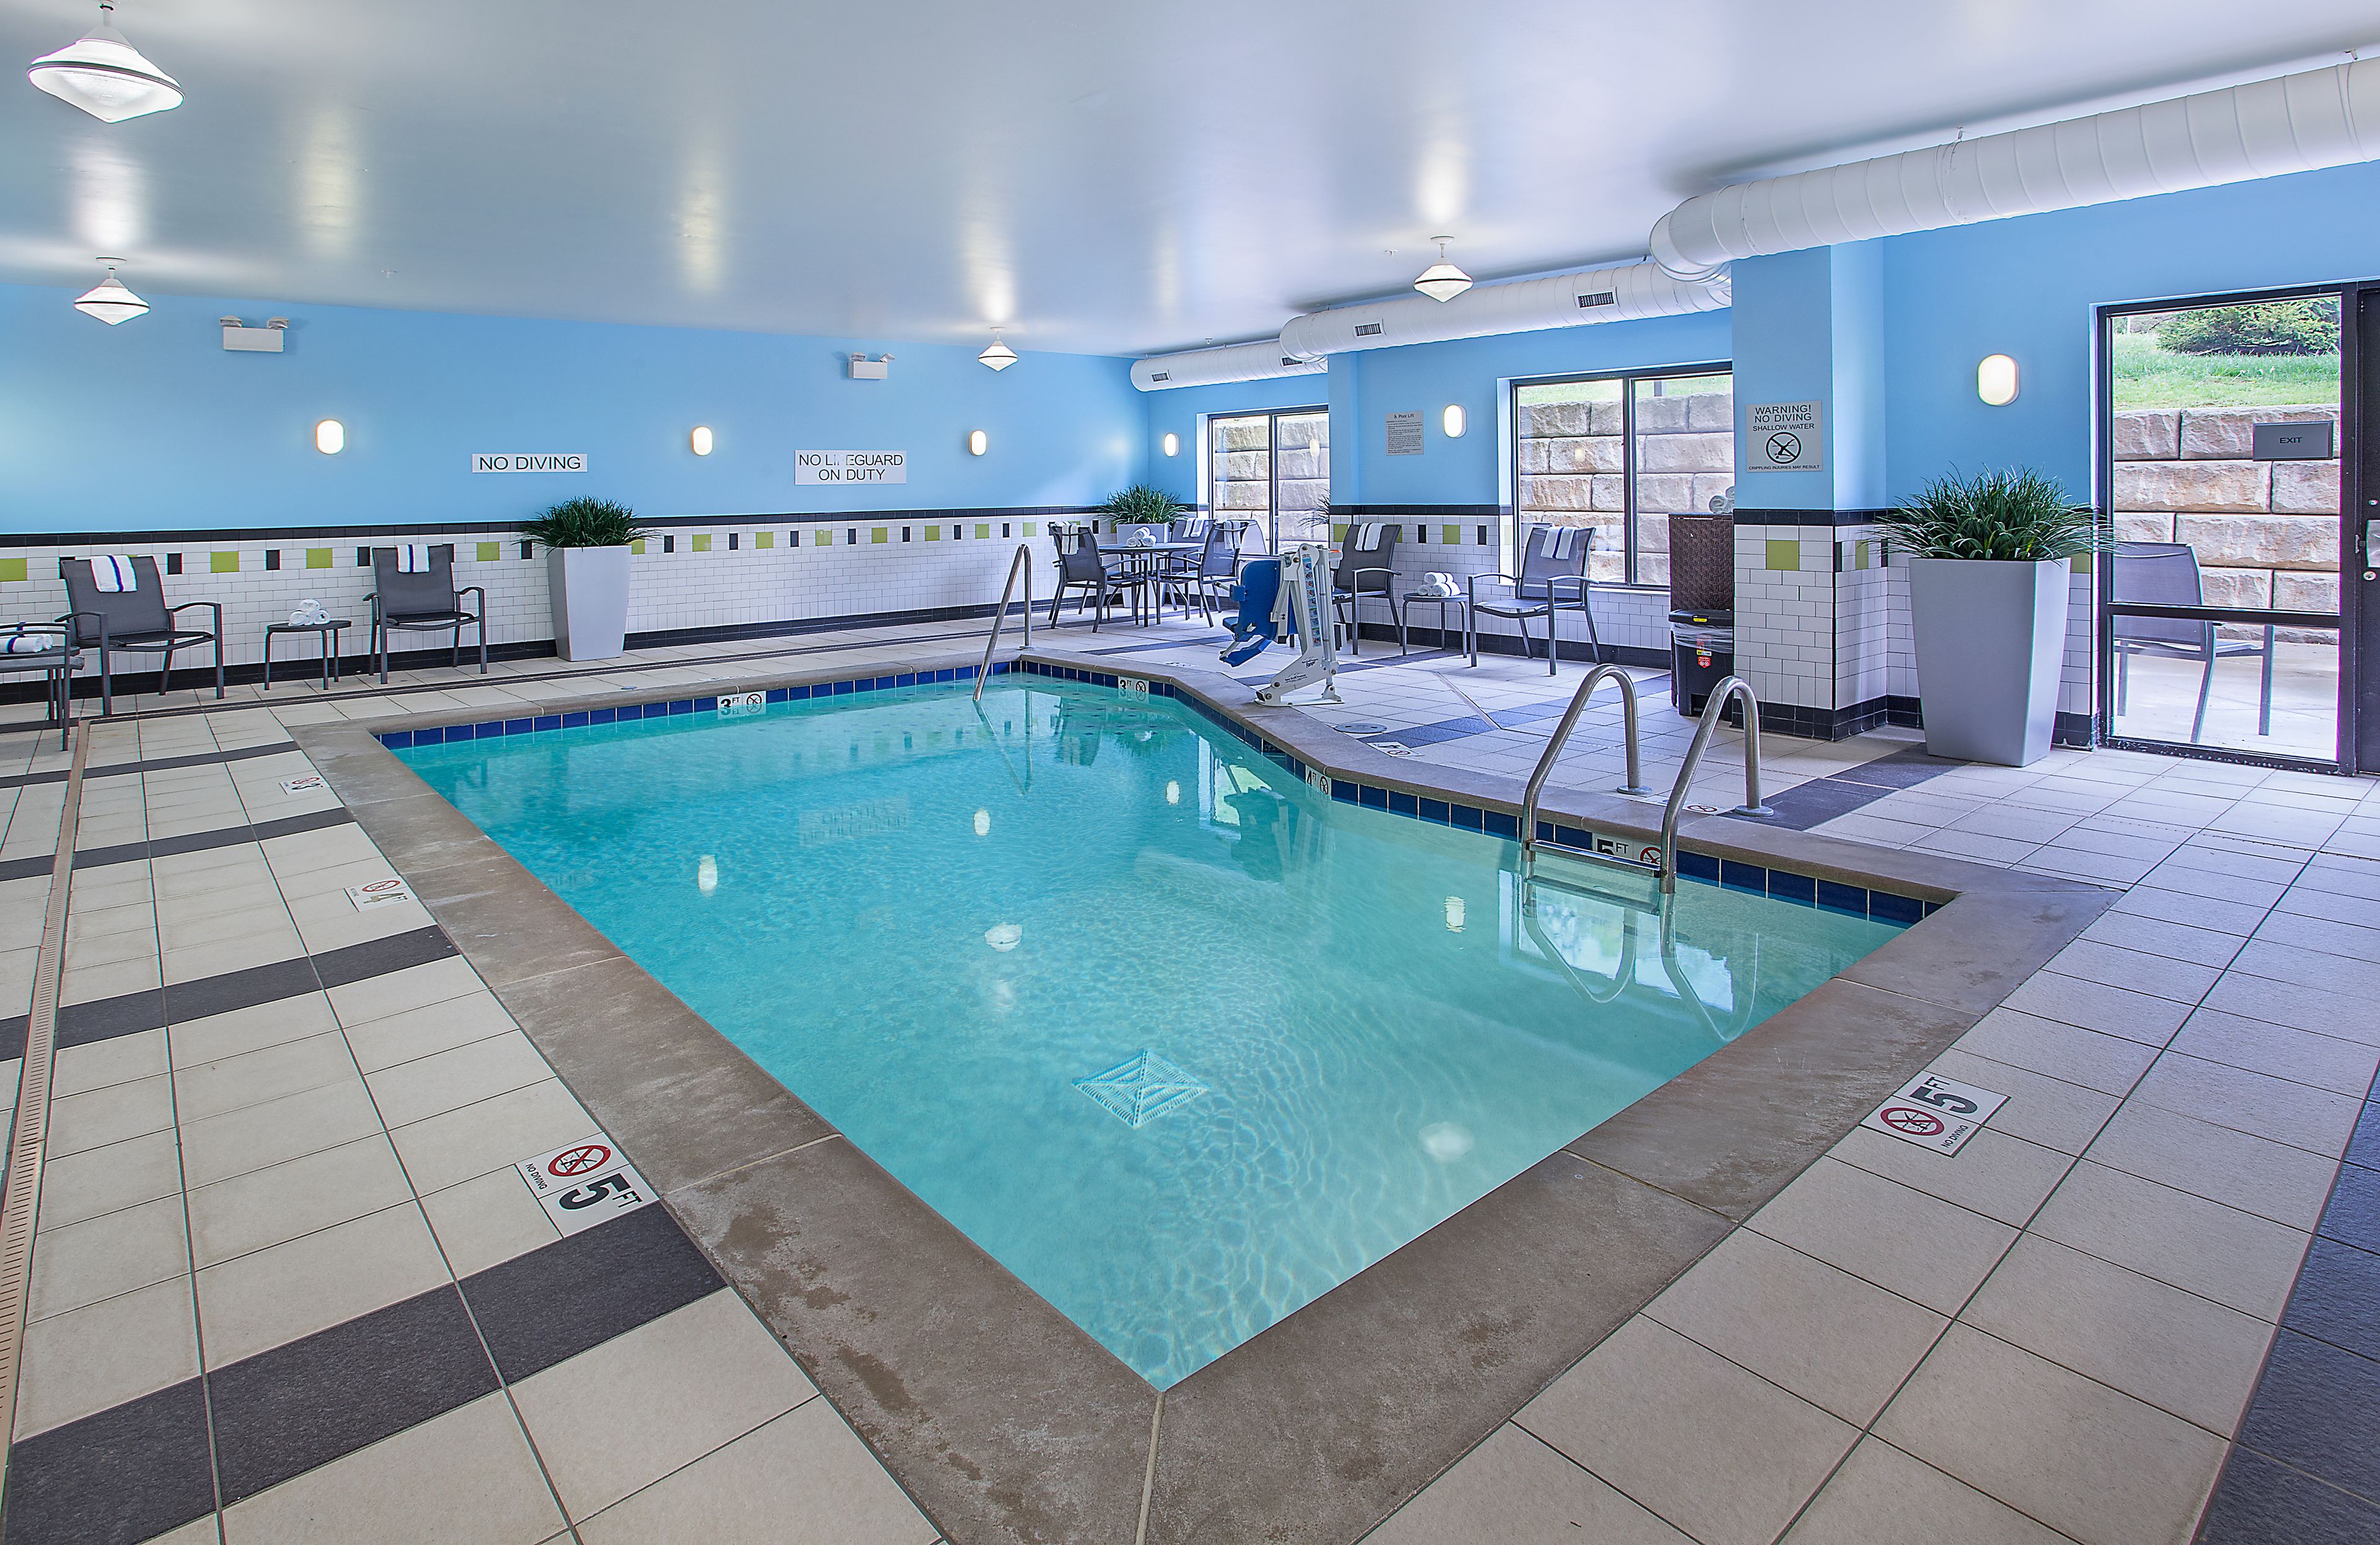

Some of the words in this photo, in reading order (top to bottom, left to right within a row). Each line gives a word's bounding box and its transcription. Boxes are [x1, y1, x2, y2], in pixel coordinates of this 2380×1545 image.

[1755, 404, 1811, 415] WARNING!
[1755, 415, 1770, 423] NO
[1774, 413, 1812, 422] DIVING
[479, 456, 508, 470] NO
[516, 456, 581, 470] DIVING
[799, 454, 821, 466] NO
[826, 454, 903, 466] LIEGUARD
[819, 469, 840, 480] ON
[847, 469, 886, 480] DUTY
[1119, 680, 1126, 689] 3
[720, 698, 731, 708] 3
[1307, 770, 1313, 787] 4
[1312, 772, 1317, 781] FT
[1616, 842, 1629, 854] FT
[1924, 1076, 1950, 1091] FT
[1909, 1086, 1978, 1114] 5
[1941, 1140, 1954, 1148] NO
[1949, 1125, 1968, 1141] DIVING
[526, 1163, 536, 1172] NO
[531, 1171, 547, 1190] DIVING
[559, 1172, 631, 1210] 5
[612, 1190, 643, 1208] FT
